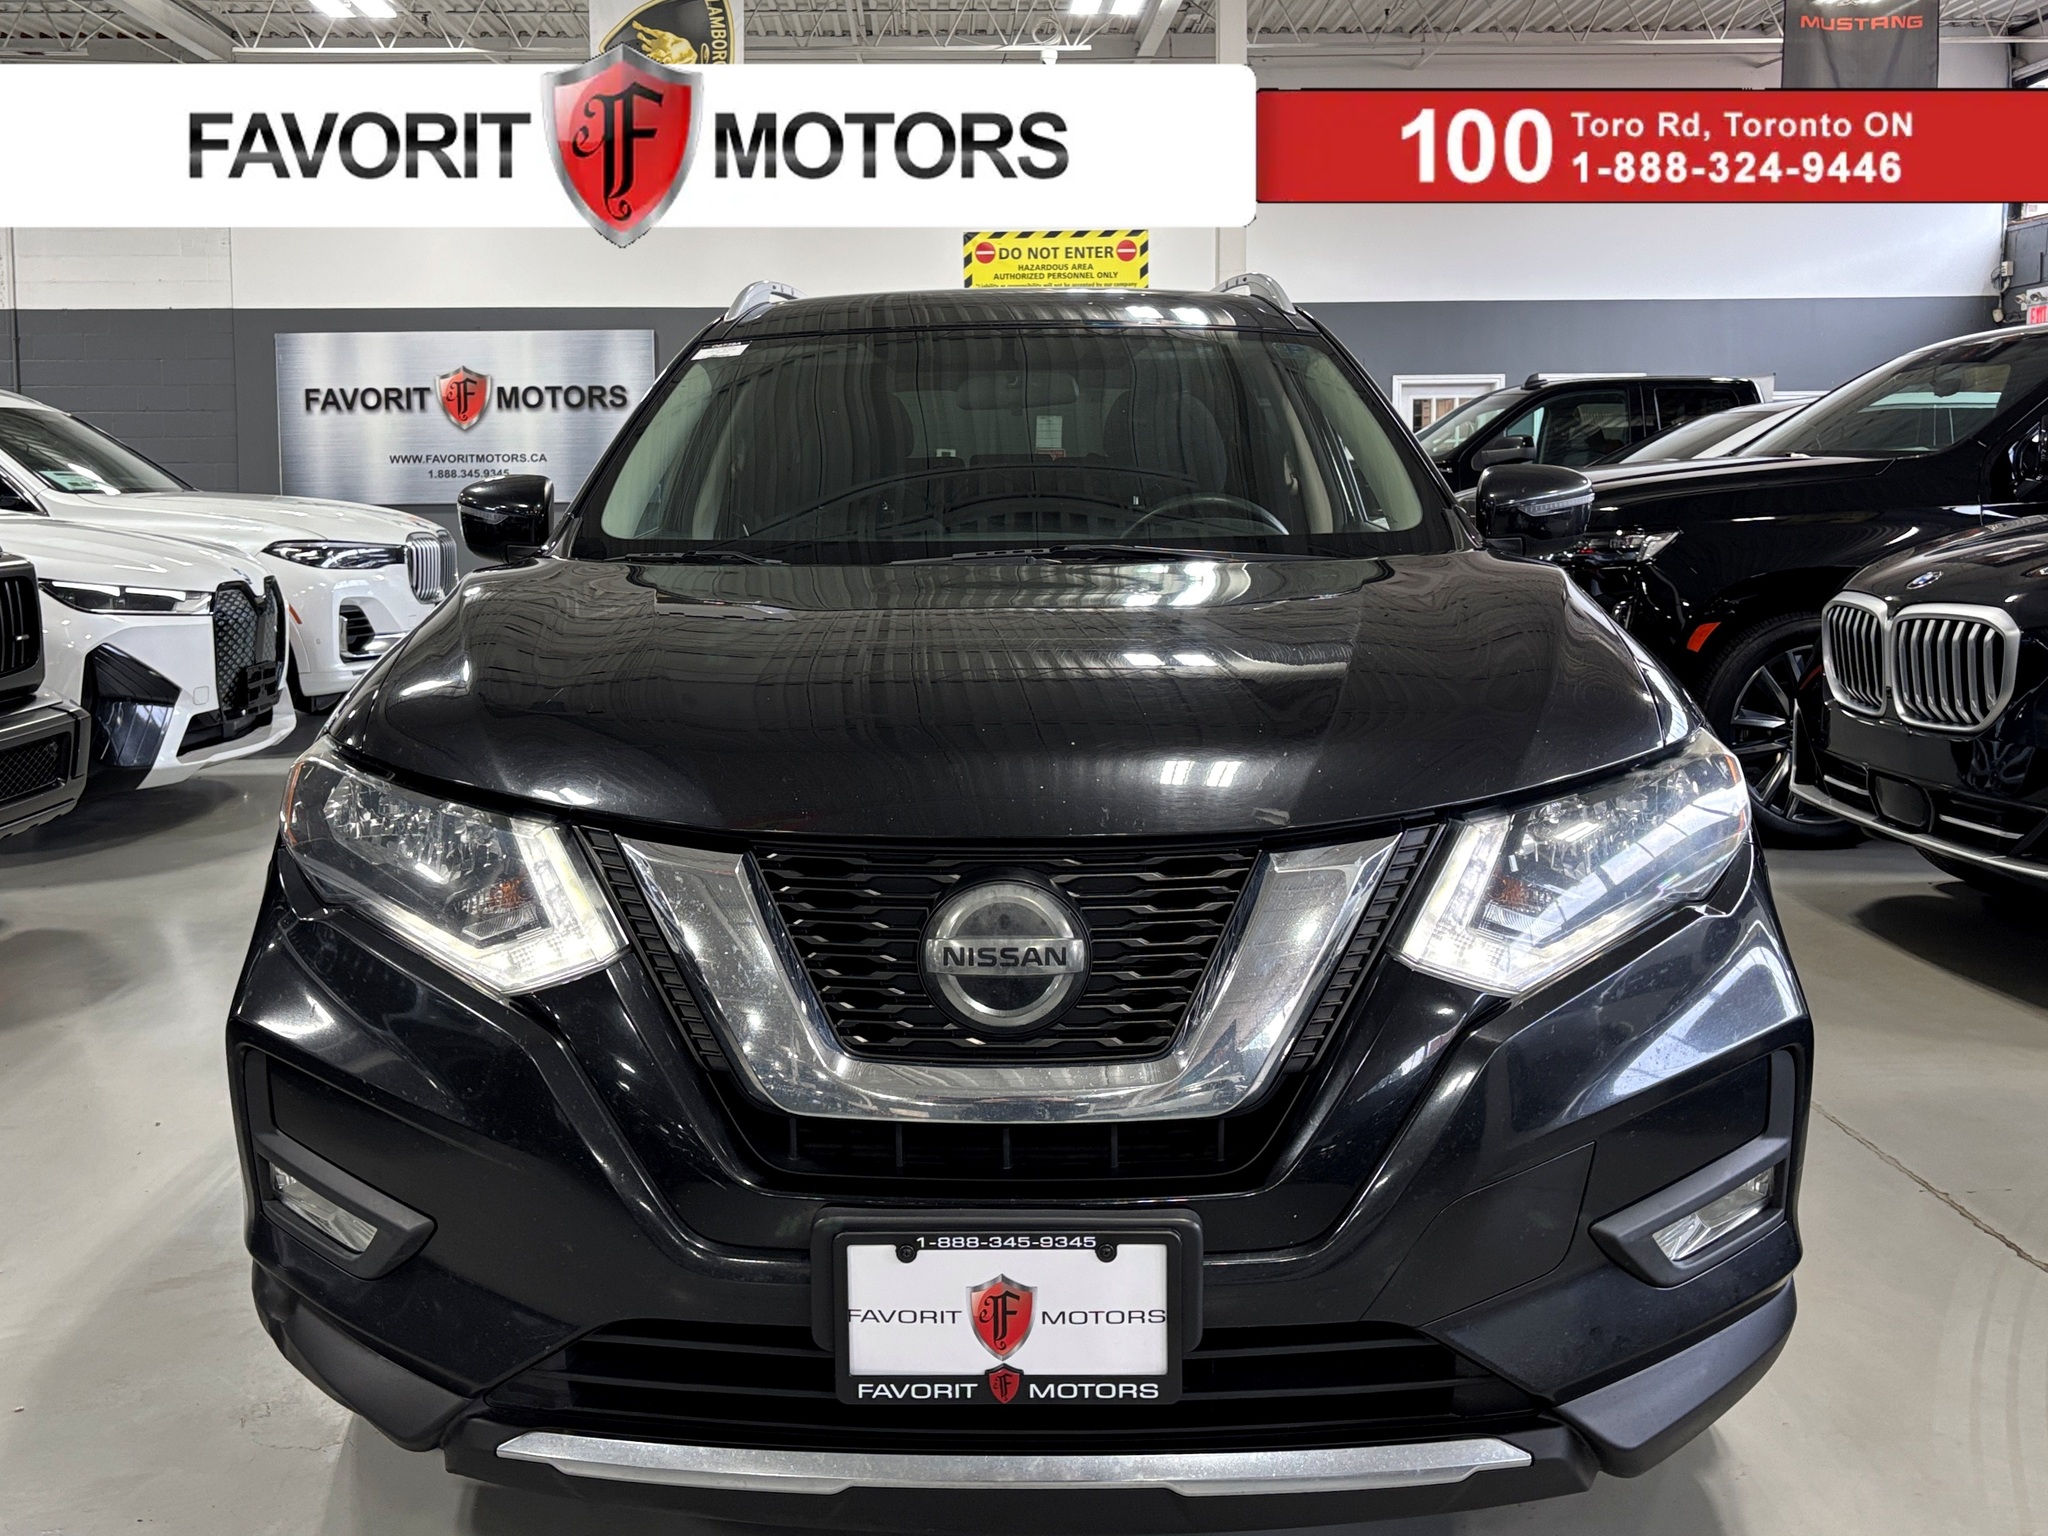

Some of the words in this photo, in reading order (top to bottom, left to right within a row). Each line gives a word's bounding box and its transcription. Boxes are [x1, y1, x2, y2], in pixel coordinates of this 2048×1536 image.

[1800, 15, 1924, 31] MUSTANG
[999, 247, 1022, 260] DO
[1027, 246, 1060, 259] NOT
[1064, 246, 1114, 259] ENTER
[1071, 263, 1094, 271] AREA
[993, 272, 1046, 281] AUTHORIZED
[1047, 272, 1094, 280] PERSONNEL
[1096, 271, 1119, 279] ONLY
[305, 387, 430, 411] FAVORIT
[497, 385, 628, 410] MOTORS
[389, 453, 547, 464] WWW.FAVORITMOTORS.CA
[943, 947, 1067, 967] NISSAN
[916, 1236, 1097, 1248] 1-888-345-9345
[849, 1309, 963, 1325] FAVORIT
[1041, 1309, 1165, 1325] MOTORS
[858, 1383, 979, 1399] FAVORIT
[1029, 1383, 1159, 1399] MOTORS
